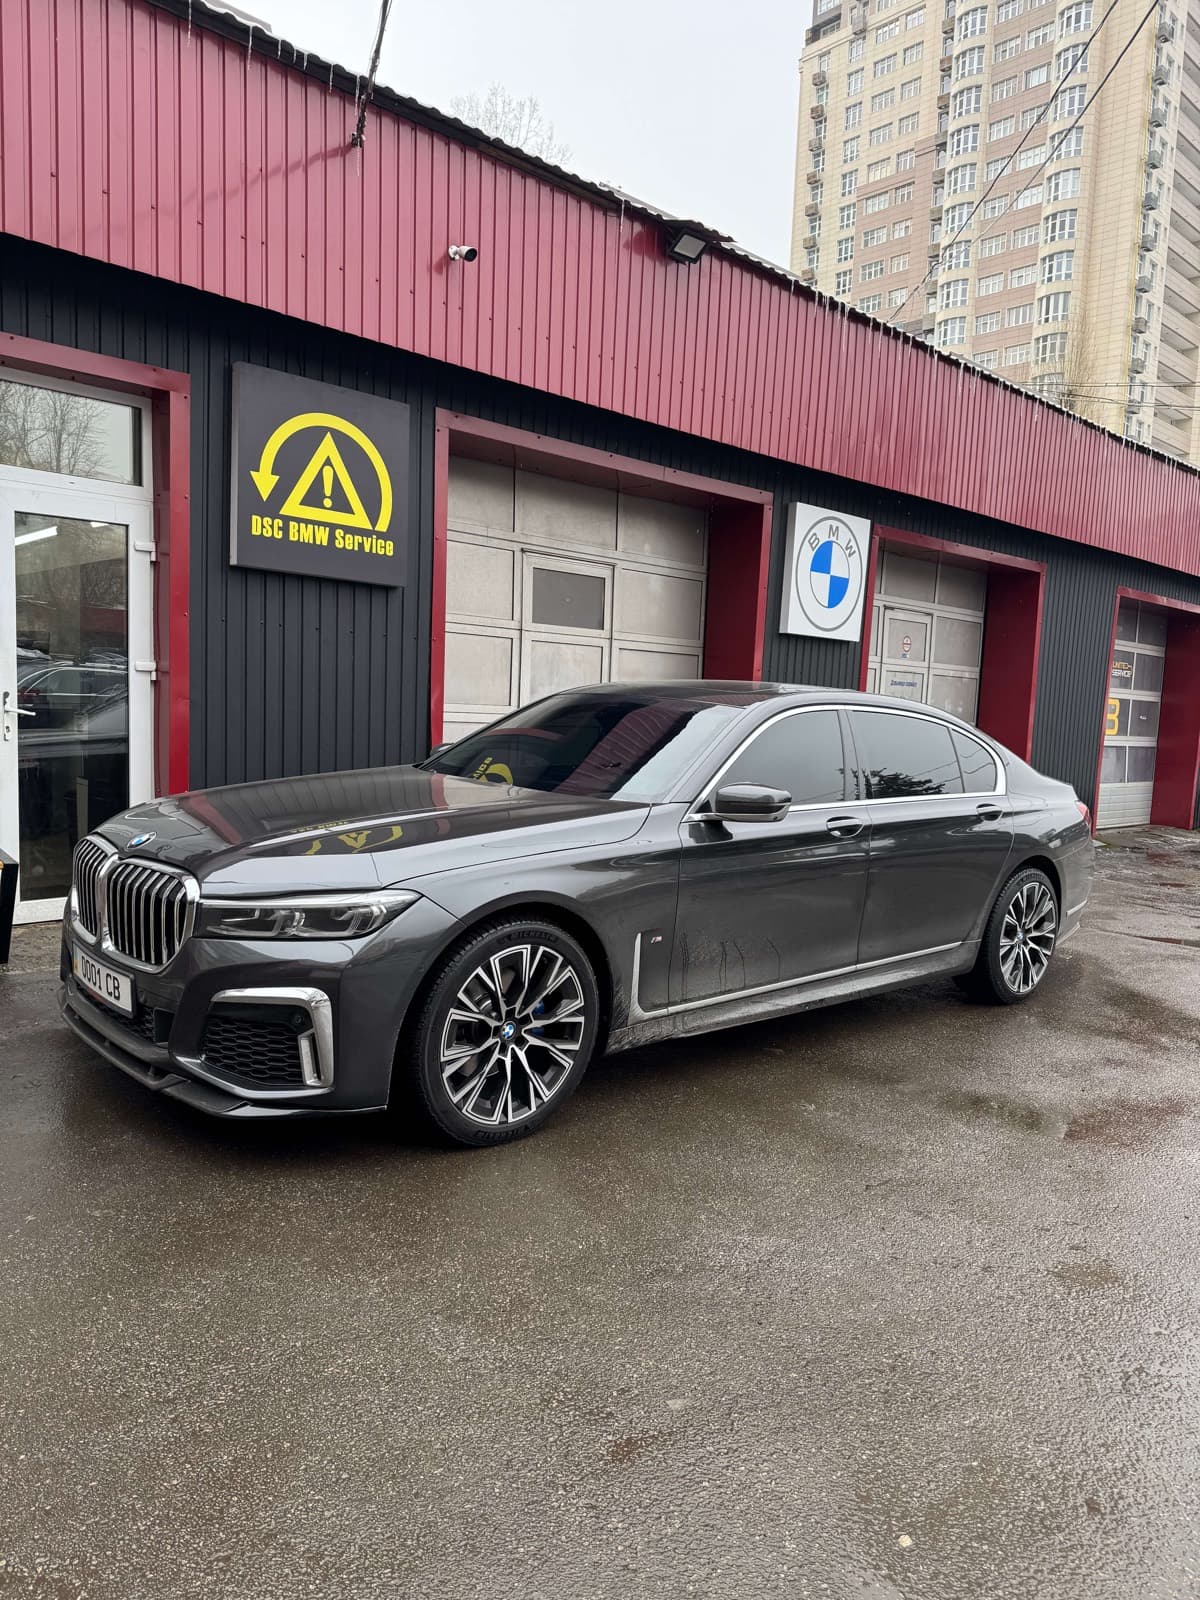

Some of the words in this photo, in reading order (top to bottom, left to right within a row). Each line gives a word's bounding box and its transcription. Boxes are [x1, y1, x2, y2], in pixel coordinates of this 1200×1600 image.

[251, 515, 283, 539] DSC
[289, 521, 329, 546] BMW
[335, 529, 394, 556] Service
[807, 524, 857, 558] BMW
